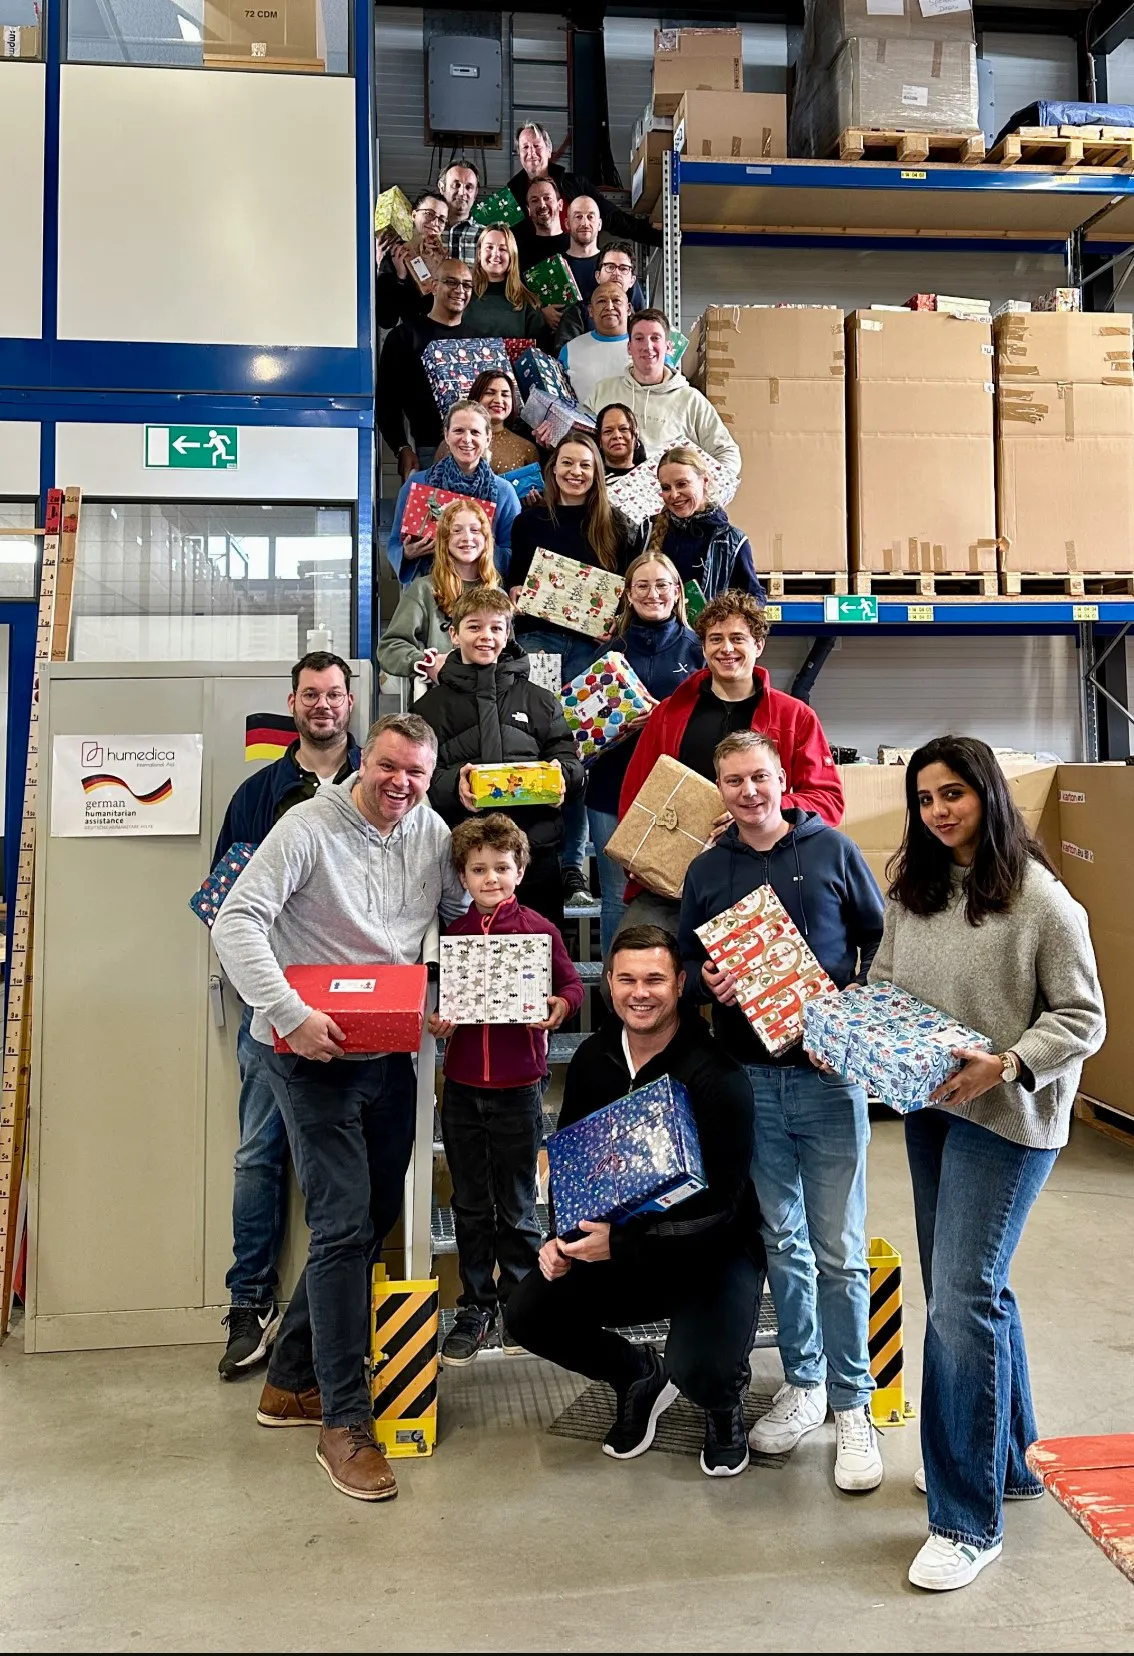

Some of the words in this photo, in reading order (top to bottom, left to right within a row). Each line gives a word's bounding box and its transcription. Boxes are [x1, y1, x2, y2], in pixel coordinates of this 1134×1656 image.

[244, 10, 255, 18] 72
[257, 10, 278, 19] CDM
[107, 747, 175, 761] humedica
[85, 800, 126, 810] german
